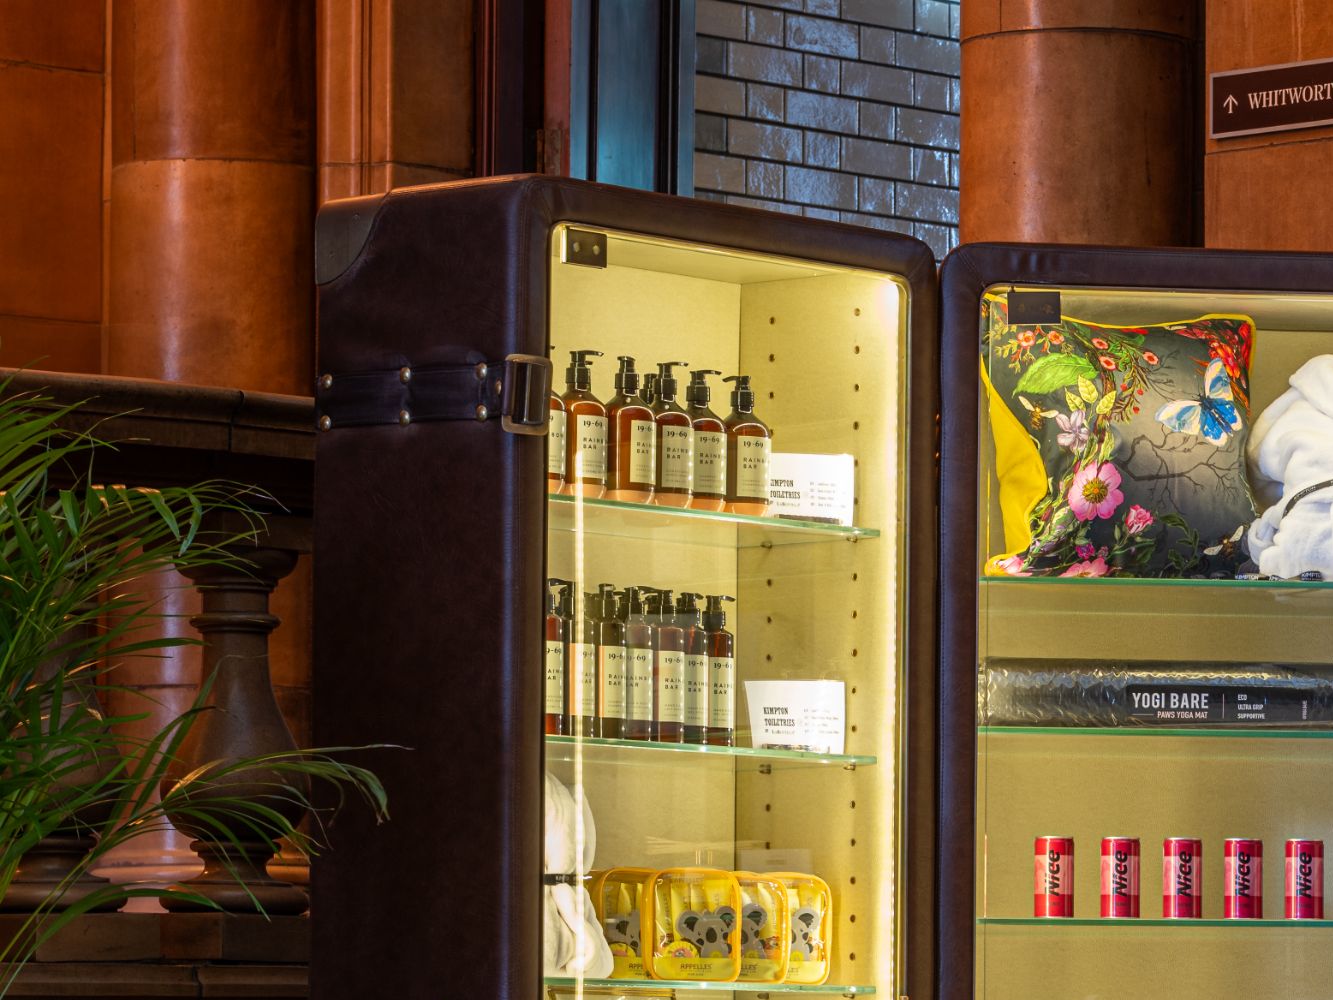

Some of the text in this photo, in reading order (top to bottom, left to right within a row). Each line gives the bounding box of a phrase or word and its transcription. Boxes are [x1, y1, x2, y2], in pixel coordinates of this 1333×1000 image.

[667, 430, 688, 439] 19-69
[700, 436, 720, 444] 19-69
[743, 440, 764, 449] 19-69
[1132, 693, 1209, 709] YOGI BARE
[763, 706, 789, 715] KIMPTON
[1157, 711, 1208, 719] PAWS YOGA MAT
[764, 718, 795, 727] TOILETRIES
